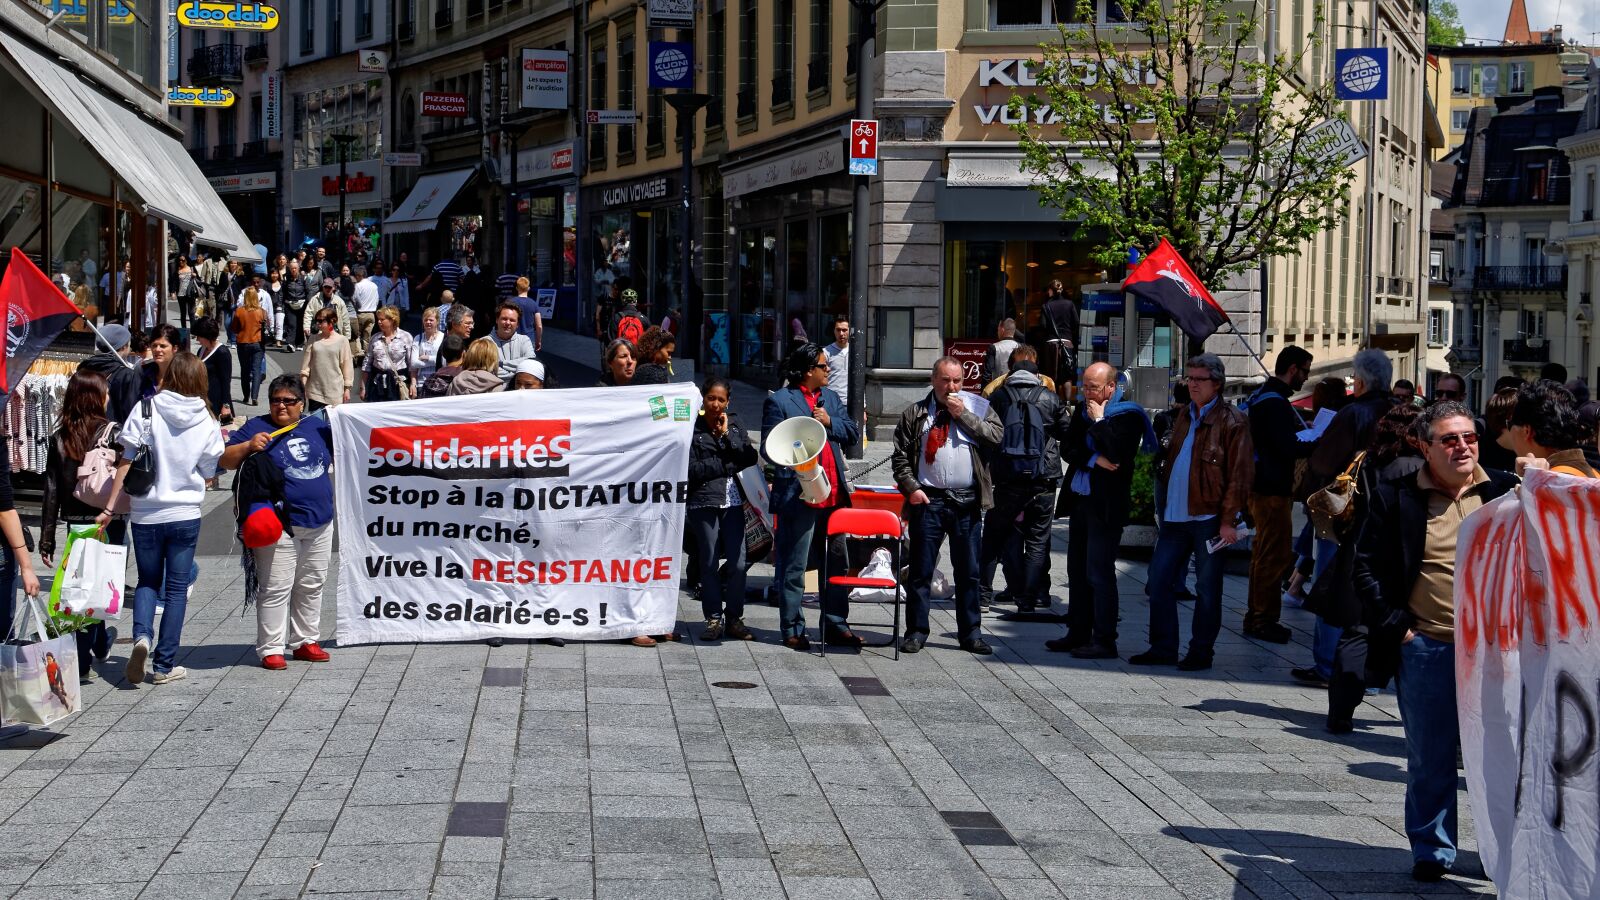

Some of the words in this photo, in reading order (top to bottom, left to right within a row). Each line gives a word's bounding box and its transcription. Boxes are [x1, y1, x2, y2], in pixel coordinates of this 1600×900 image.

[184, 0, 225, 20] doo
[227, 2, 268, 23] dah
[655, 59, 689, 71] KUONI
[1342, 66, 1382, 82] KUONI
[168, 86, 196, 100] doo
[197, 86, 226, 101] dah
[425, 95, 465, 103] PIZZERIA
[267, 76, 275, 137] mobilezone
[424, 104, 465, 112] FRASCATI
[603, 185, 629, 207] KUONI
[629, 177, 667, 202] VOYAGES
[367, 484, 440, 509] Stop
[447, 484, 466, 506] à
[475, 486, 504, 509] la
[366, 515, 404, 537] du
[412, 520, 541, 548] marché,
[365, 556, 427, 578] Vive
[435, 556, 464, 579] la
[472, 557, 673, 585] RESISTANCE
[363, 596, 418, 620] des
[425, 599, 589, 626] salarié-e-s
[599, 602, 608, 625] !
